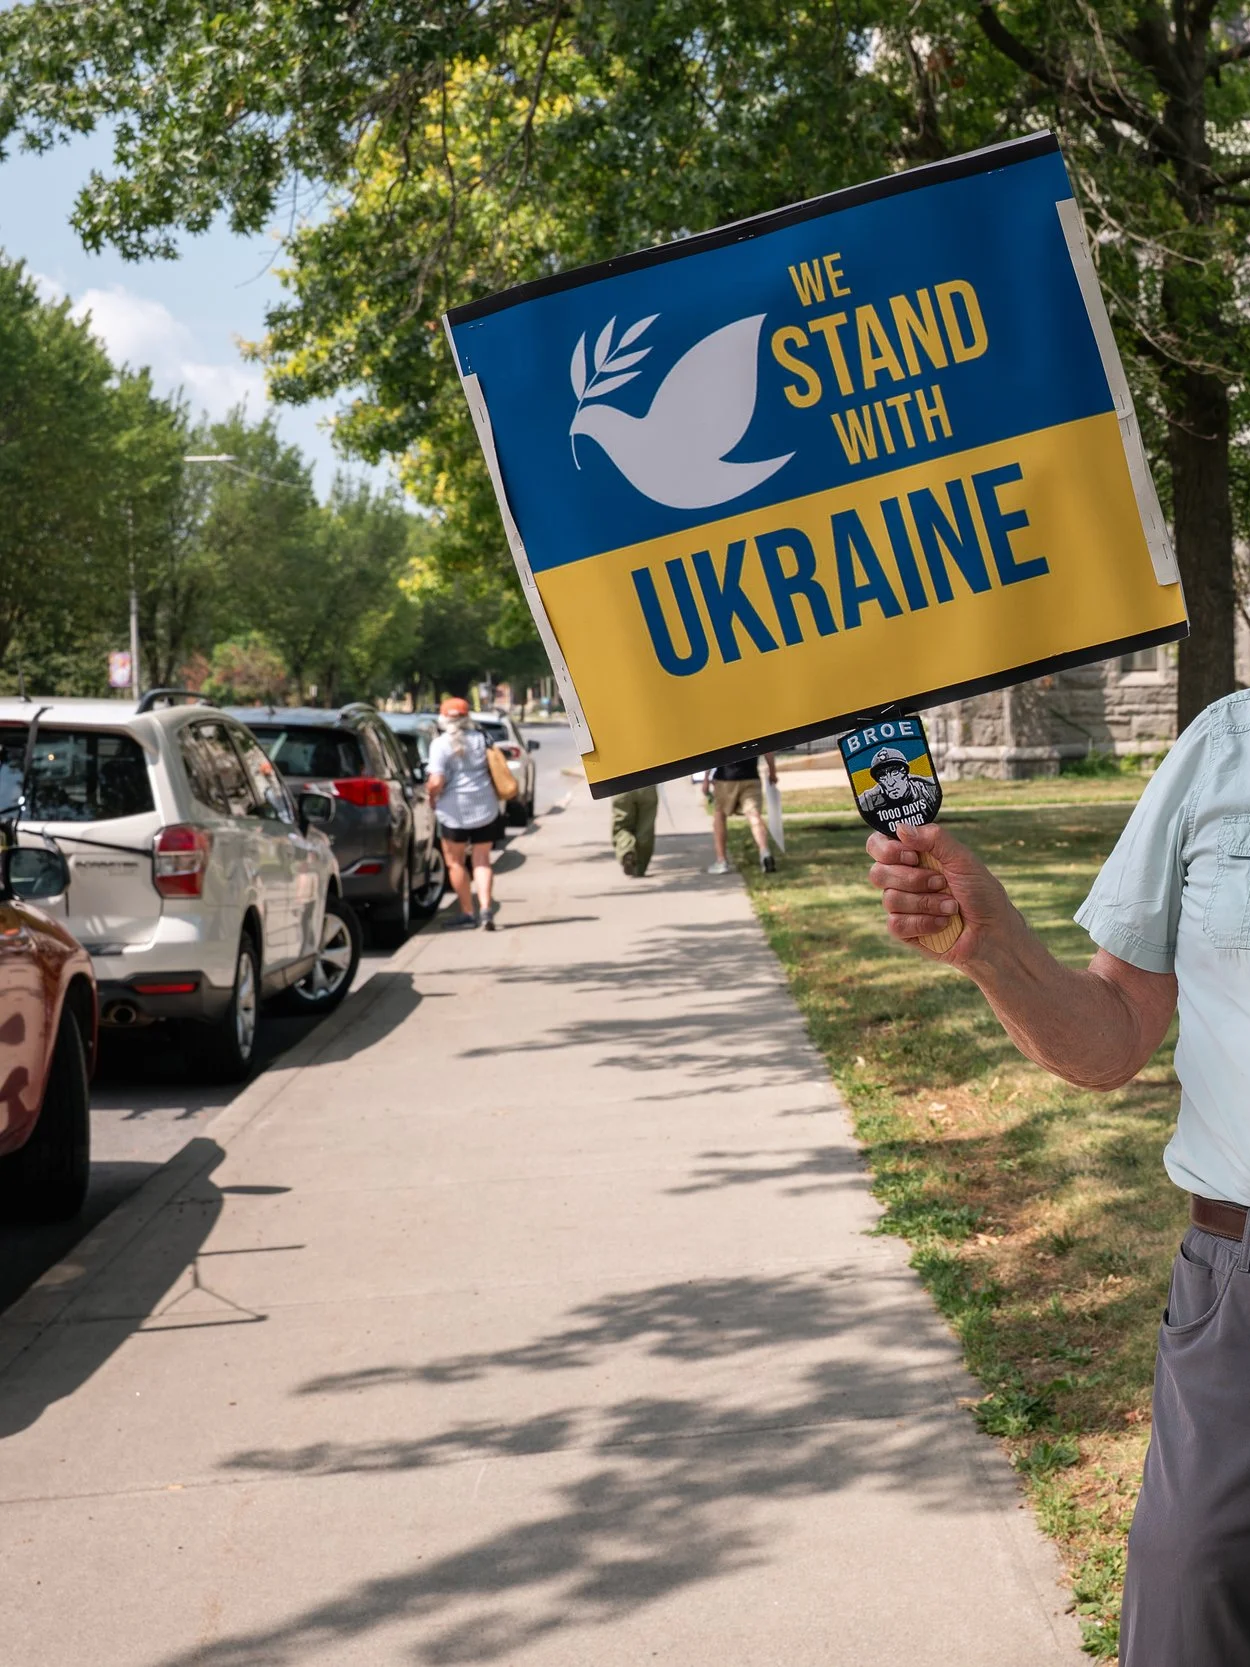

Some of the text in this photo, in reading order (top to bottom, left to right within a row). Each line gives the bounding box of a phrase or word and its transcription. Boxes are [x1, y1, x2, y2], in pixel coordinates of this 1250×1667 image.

[788, 252, 851, 307] WE
[770, 279, 989, 409] STAND
[831, 384, 953, 466] WITH
[631, 462, 1049, 677] UKRAINE
[846, 721, 914, 753] BROE
[876, 798, 927, 822] 1000 DAYS
